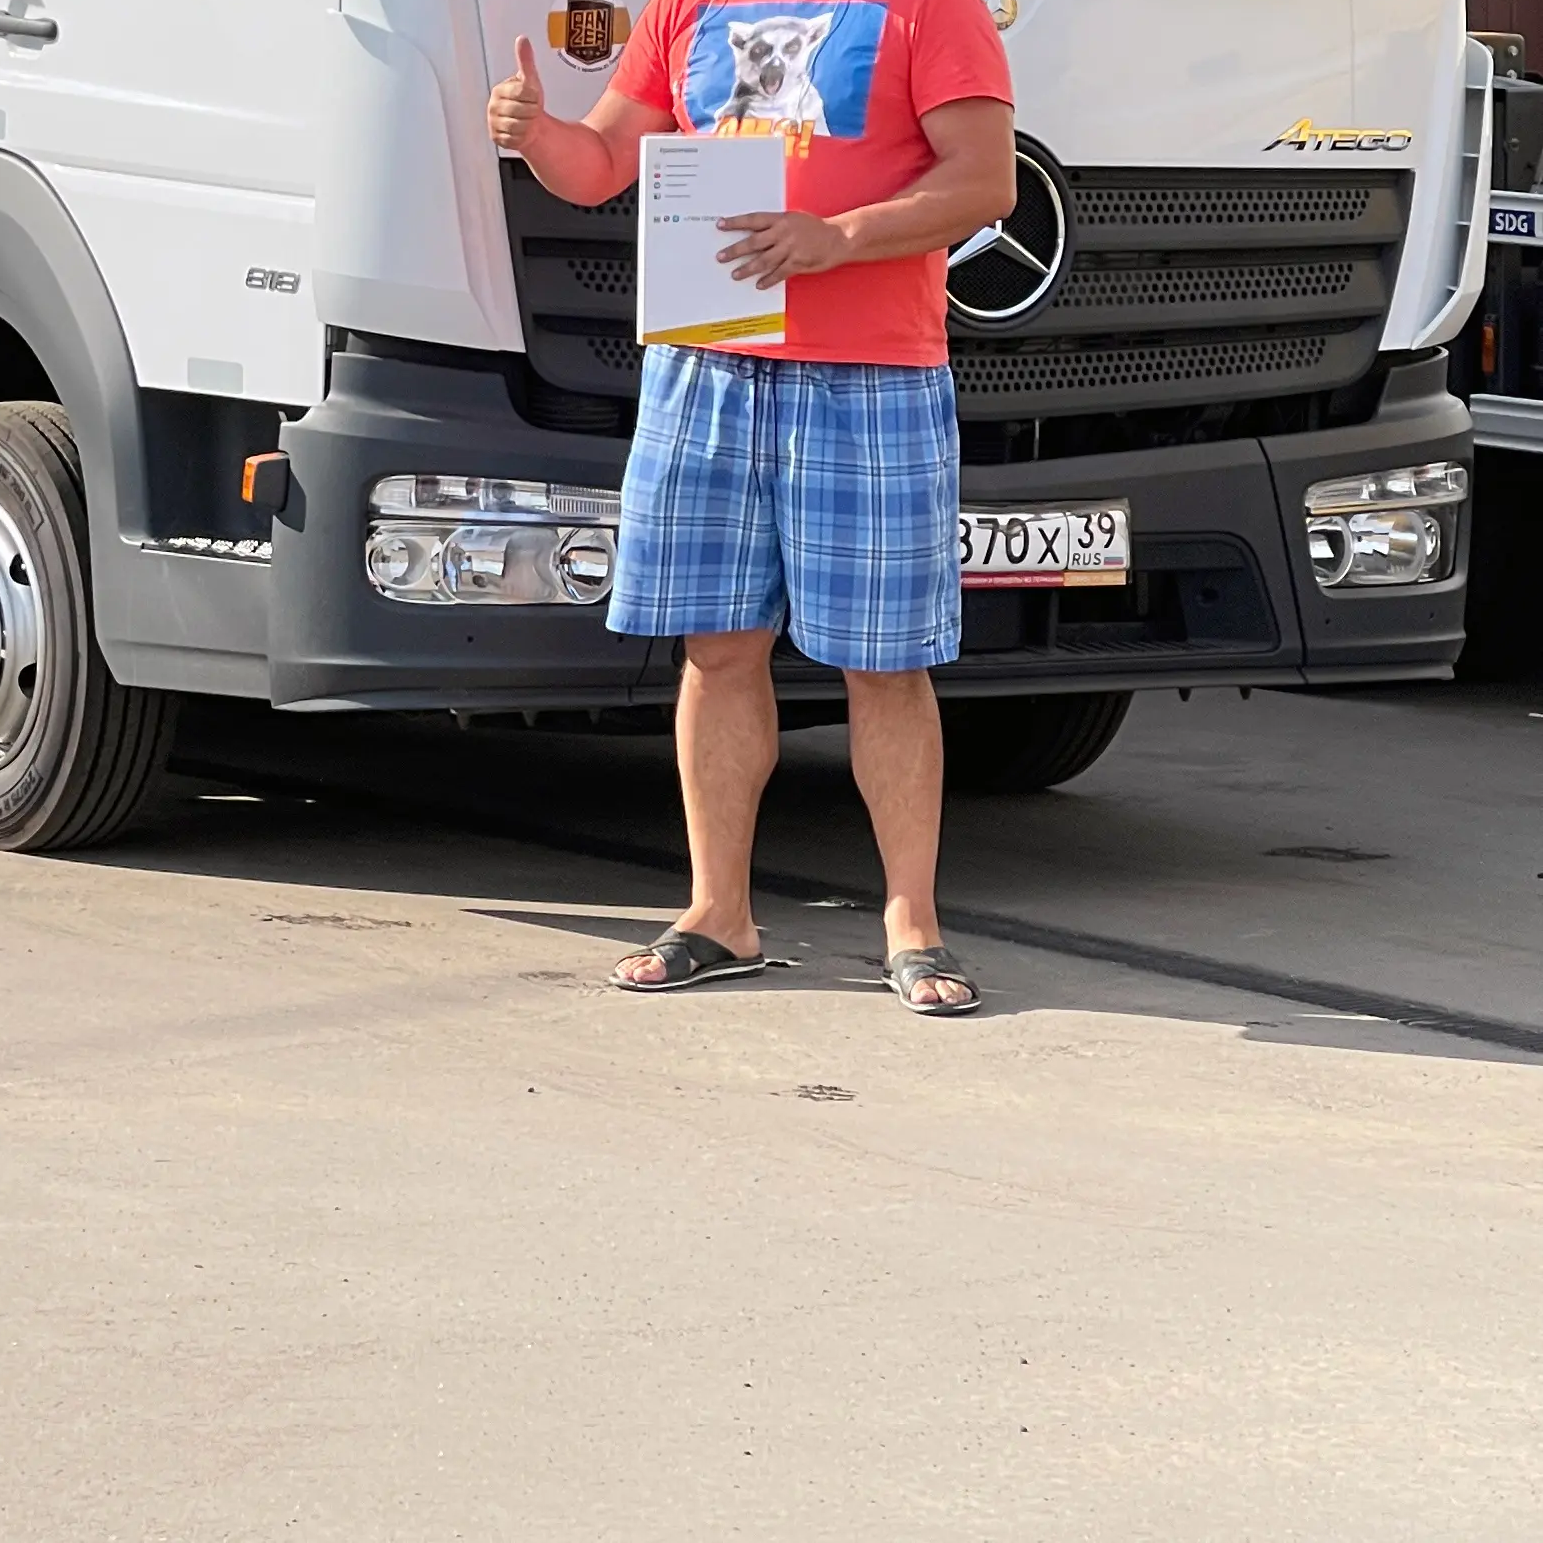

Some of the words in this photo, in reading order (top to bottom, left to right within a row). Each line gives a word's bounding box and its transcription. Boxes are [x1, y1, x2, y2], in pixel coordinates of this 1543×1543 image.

[1495, 212, 1529, 233] SDG
[245, 266, 301, 295] 818
[1074, 513, 1116, 549] 39
[1071, 552, 1102, 566] RUS
